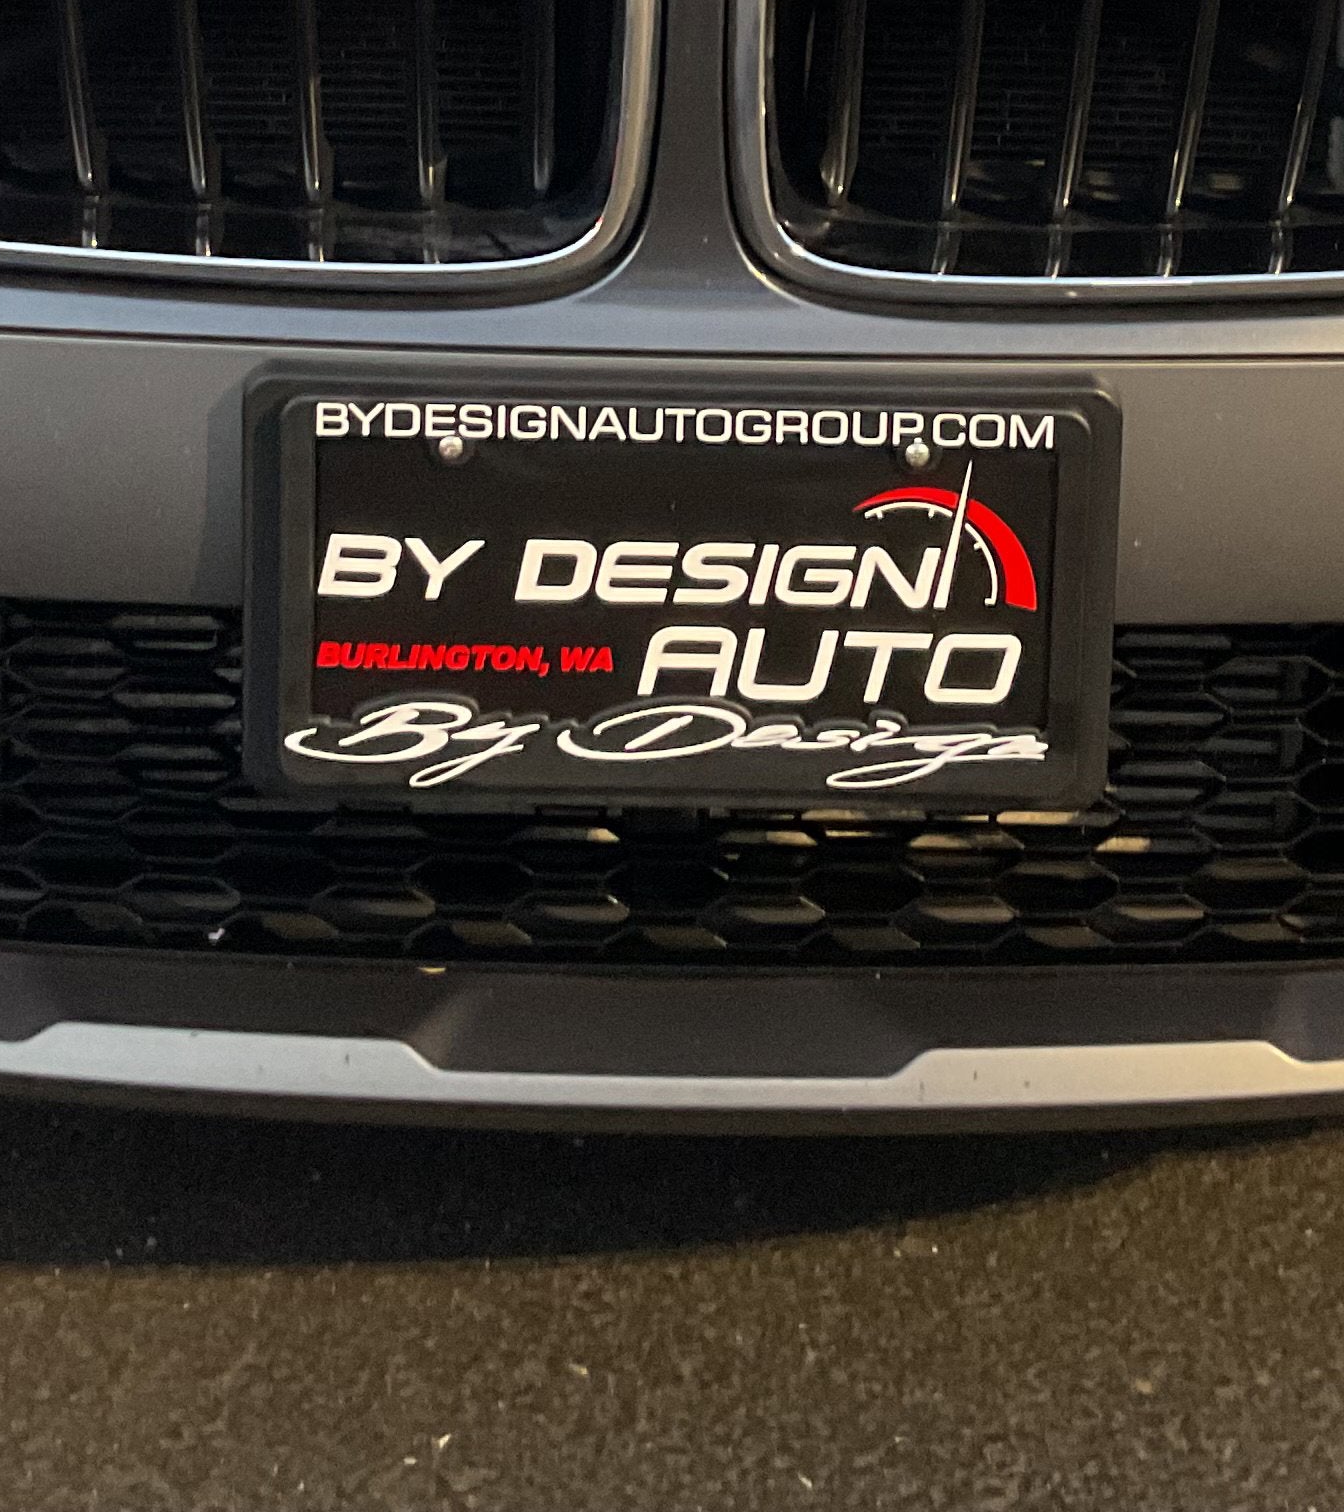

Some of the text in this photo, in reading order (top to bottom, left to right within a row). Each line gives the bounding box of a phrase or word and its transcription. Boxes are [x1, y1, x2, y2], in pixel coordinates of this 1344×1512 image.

[316, 402, 1055, 450] BYDESIGNAUTOGROUP.COM
[317, 533, 943, 609] BY DESIGN
[316, 641, 614, 678] BURLINGTON, WA
[636, 625, 1023, 705] AUTO
[283, 702, 1049, 789] By Design
